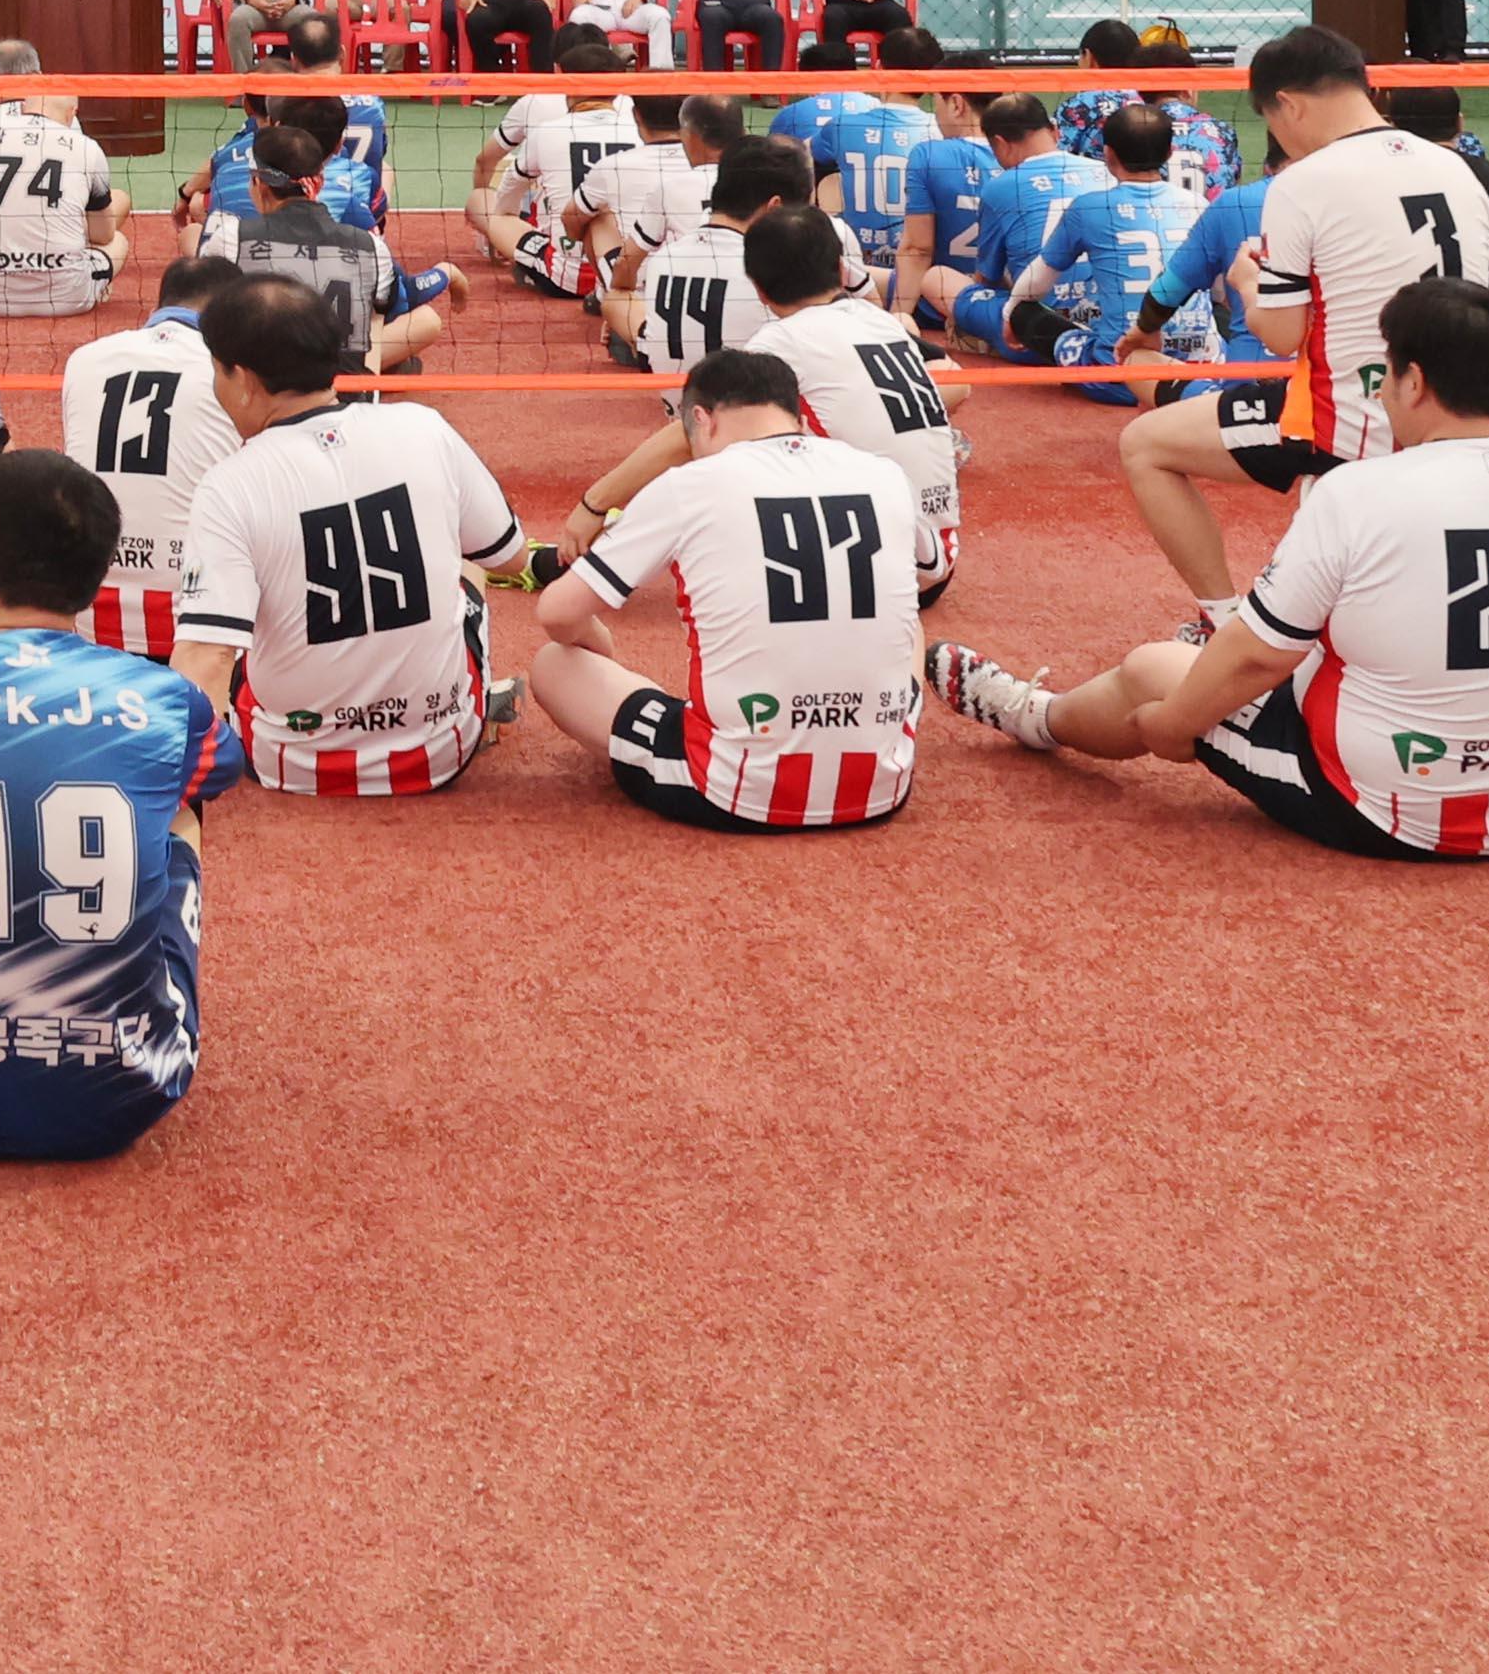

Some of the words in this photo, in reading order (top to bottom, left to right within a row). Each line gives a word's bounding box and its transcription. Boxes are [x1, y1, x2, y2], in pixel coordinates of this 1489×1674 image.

[845, 151, 909, 216] 10
[1399, 192, 1463, 280] 3
[655, 275, 728, 360] 44
[96, 370, 182, 476] 13
[921, 485, 951, 500] GOLFZON
[922, 496, 951, 516] PARK
[110, 549, 155, 570] ARK
[298, 482, 431, 646] 99
[754, 494, 883, 623] 97
[335, 697, 408, 720] GOLFZON
[791, 707, 861, 729] PARK
[792, 692, 863, 708] GOLFZON
